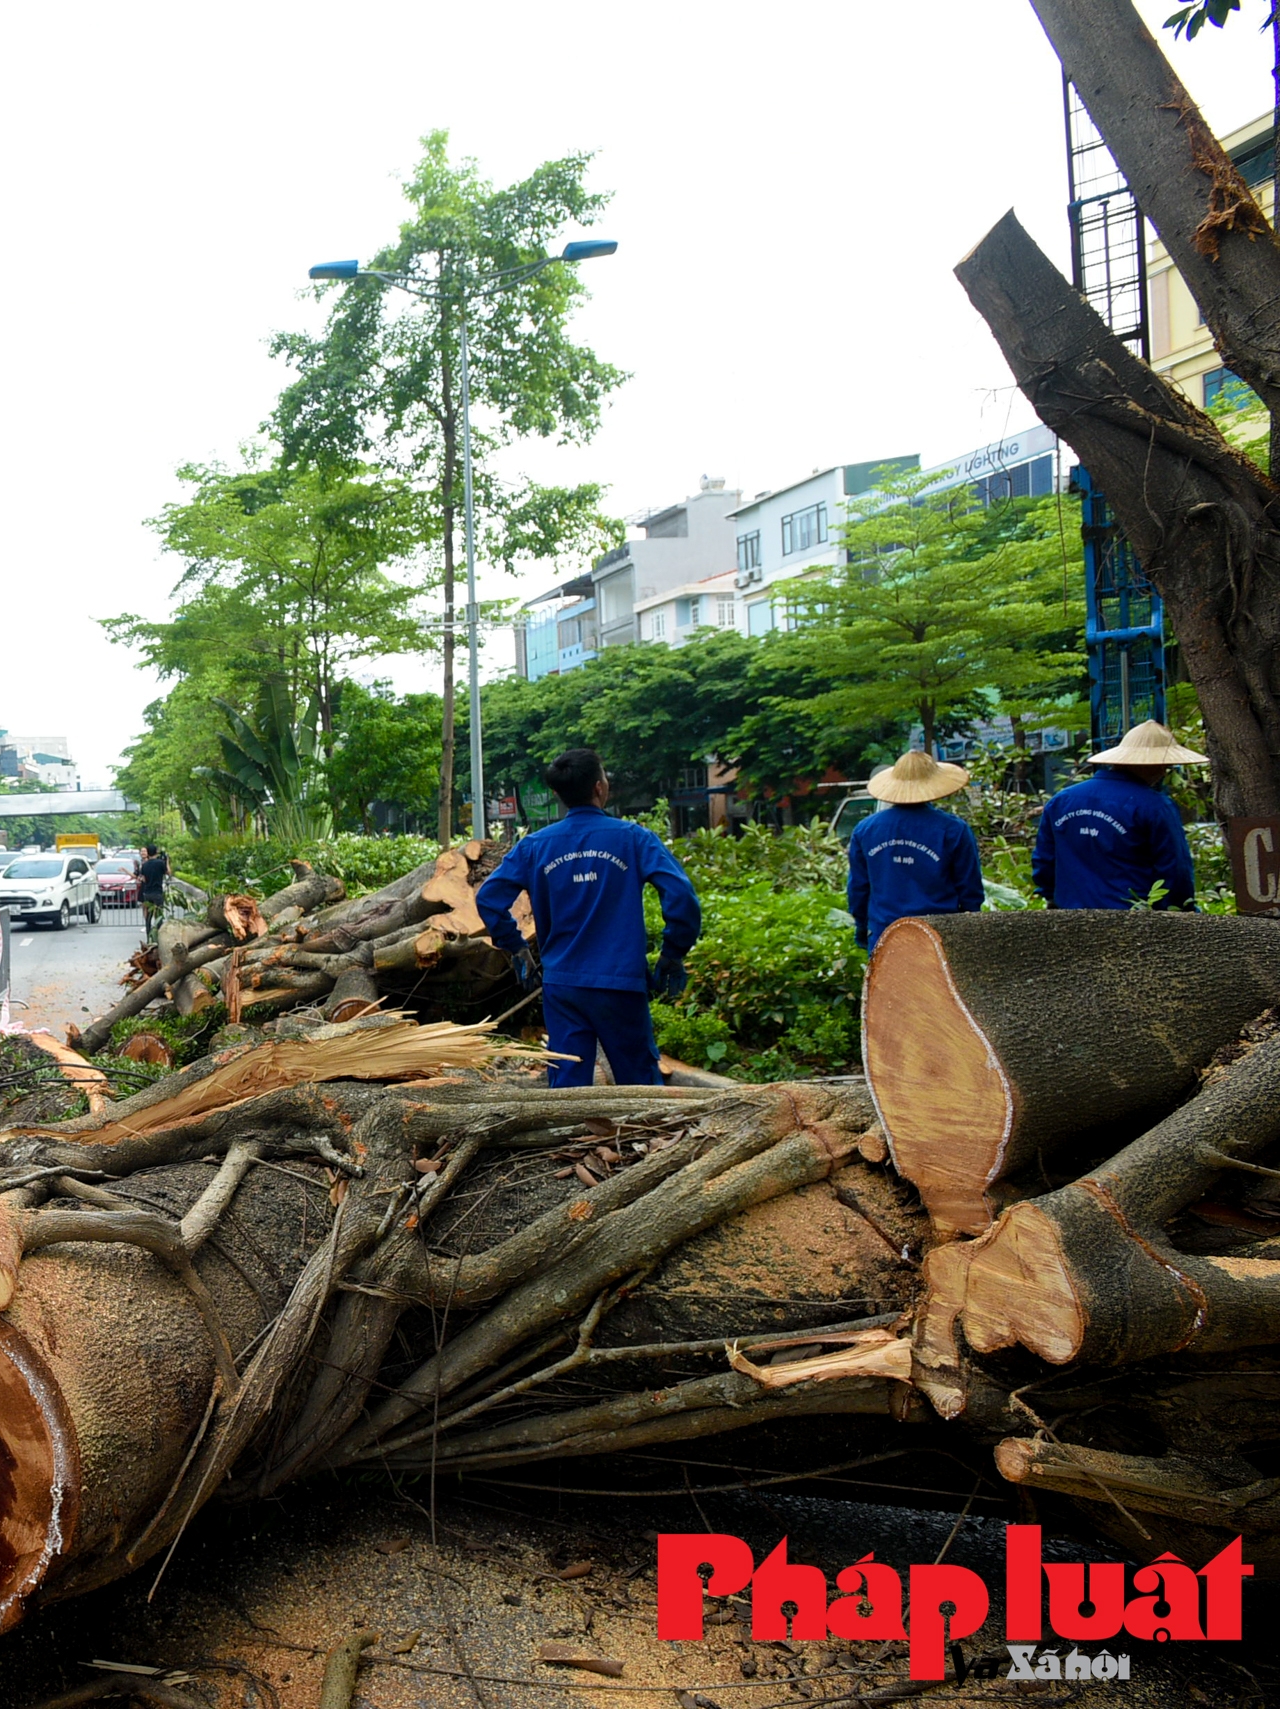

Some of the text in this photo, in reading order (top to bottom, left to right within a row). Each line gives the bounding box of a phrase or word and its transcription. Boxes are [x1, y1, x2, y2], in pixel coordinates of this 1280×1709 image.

[965, 442, 1020, 474] LIGHTING
[1055, 814, 1069, 827] CÔNG
[1067, 811, 1075, 819] TY
[1092, 810, 1105, 819] VIÊN
[1104, 814, 1114, 823] CÂY
[1111, 820, 1128, 835] XANH
[1079, 826, 1089, 835] HÀ
[555, 857, 564, 866] TY
[563, 851, 583, 861] CÔNG
[582, 849, 598, 858] VIÊN
[597, 850, 611, 859] CÂY
[610, 855, 629, 872] XANH
[868, 844, 883, 857] CÔNG
[881, 841, 889, 849] TY
[916, 843, 928, 852] CÂY
[926, 848, 941, 862] XANH
[573, 871, 598, 883] HÀ NỘI
[1244, 827, 1280, 904] C
